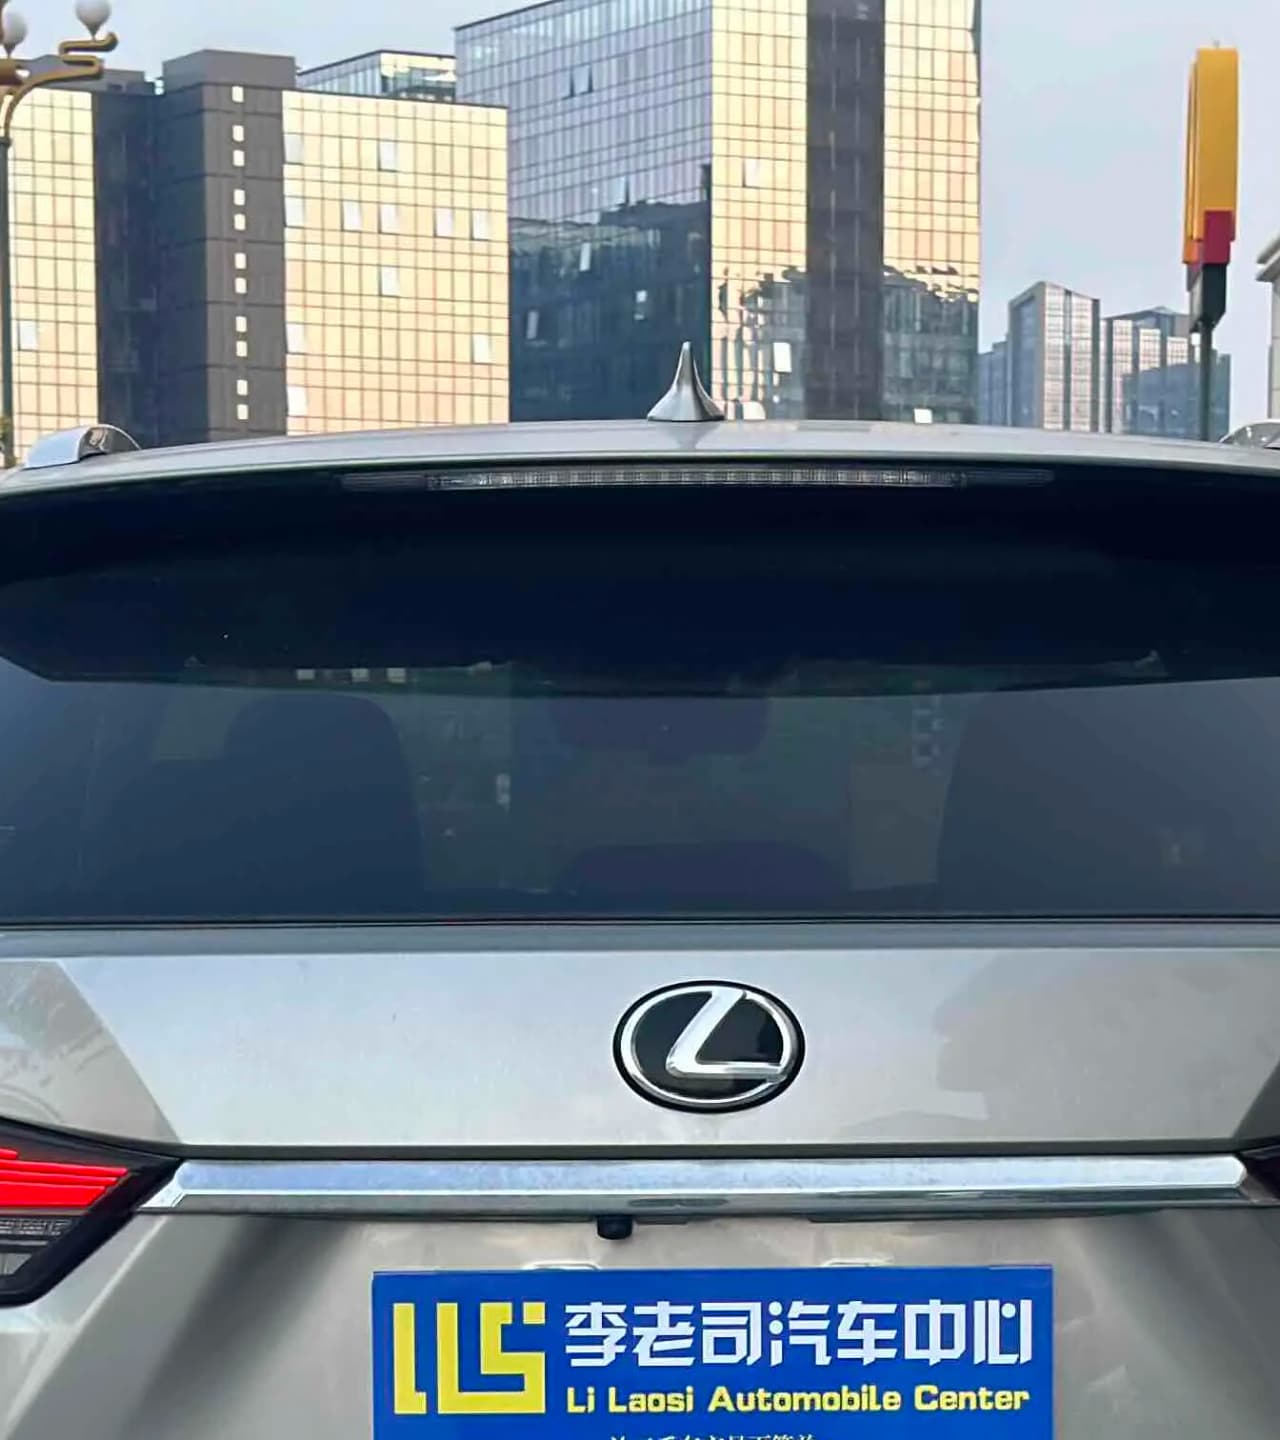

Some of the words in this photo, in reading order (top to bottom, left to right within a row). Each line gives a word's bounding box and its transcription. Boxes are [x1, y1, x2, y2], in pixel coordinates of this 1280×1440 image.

[565, 1299, 1033, 1367] 李老司汽车中心
[567, 1385, 595, 1414] Li
[608, 1385, 694, 1414] Laosi
[707, 1385, 902, 1412] Automobile
[914, 1385, 1030, 1412] Center
